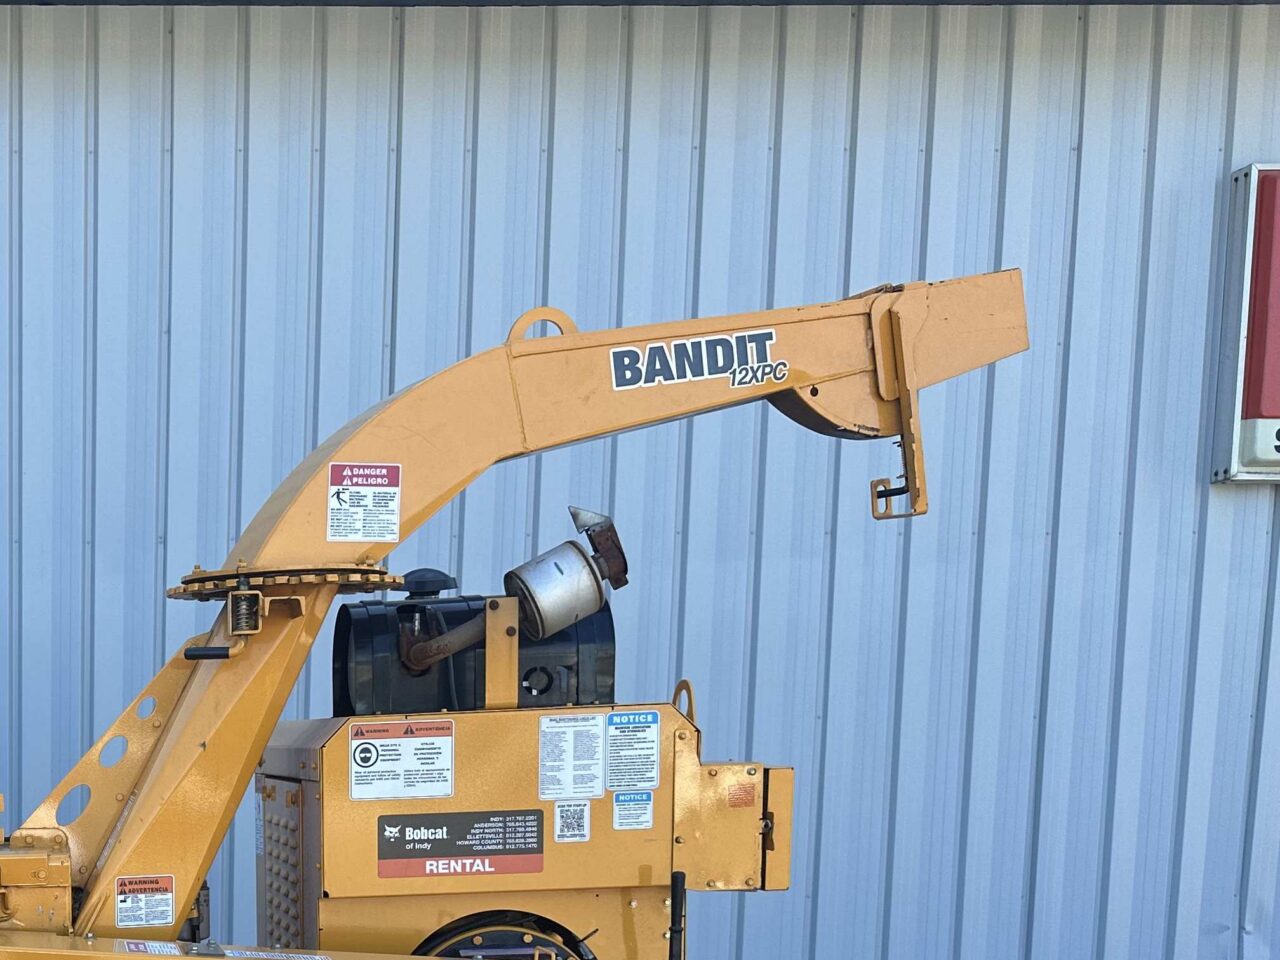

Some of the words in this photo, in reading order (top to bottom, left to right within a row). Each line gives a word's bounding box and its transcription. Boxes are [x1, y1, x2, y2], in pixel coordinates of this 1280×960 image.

[613, 331, 773, 387] BANDIT
[729, 361, 787, 387] 12XPC
[353, 477, 388, 485] PELIGRO
[613, 715, 652, 724] NOTICE
[619, 793, 648, 801] NOTICE
[405, 826, 448, 840] Bobcat
[405, 842, 414, 850] of
[415, 842, 432, 850] Indy
[426, 859, 495, 874] RENTAL
